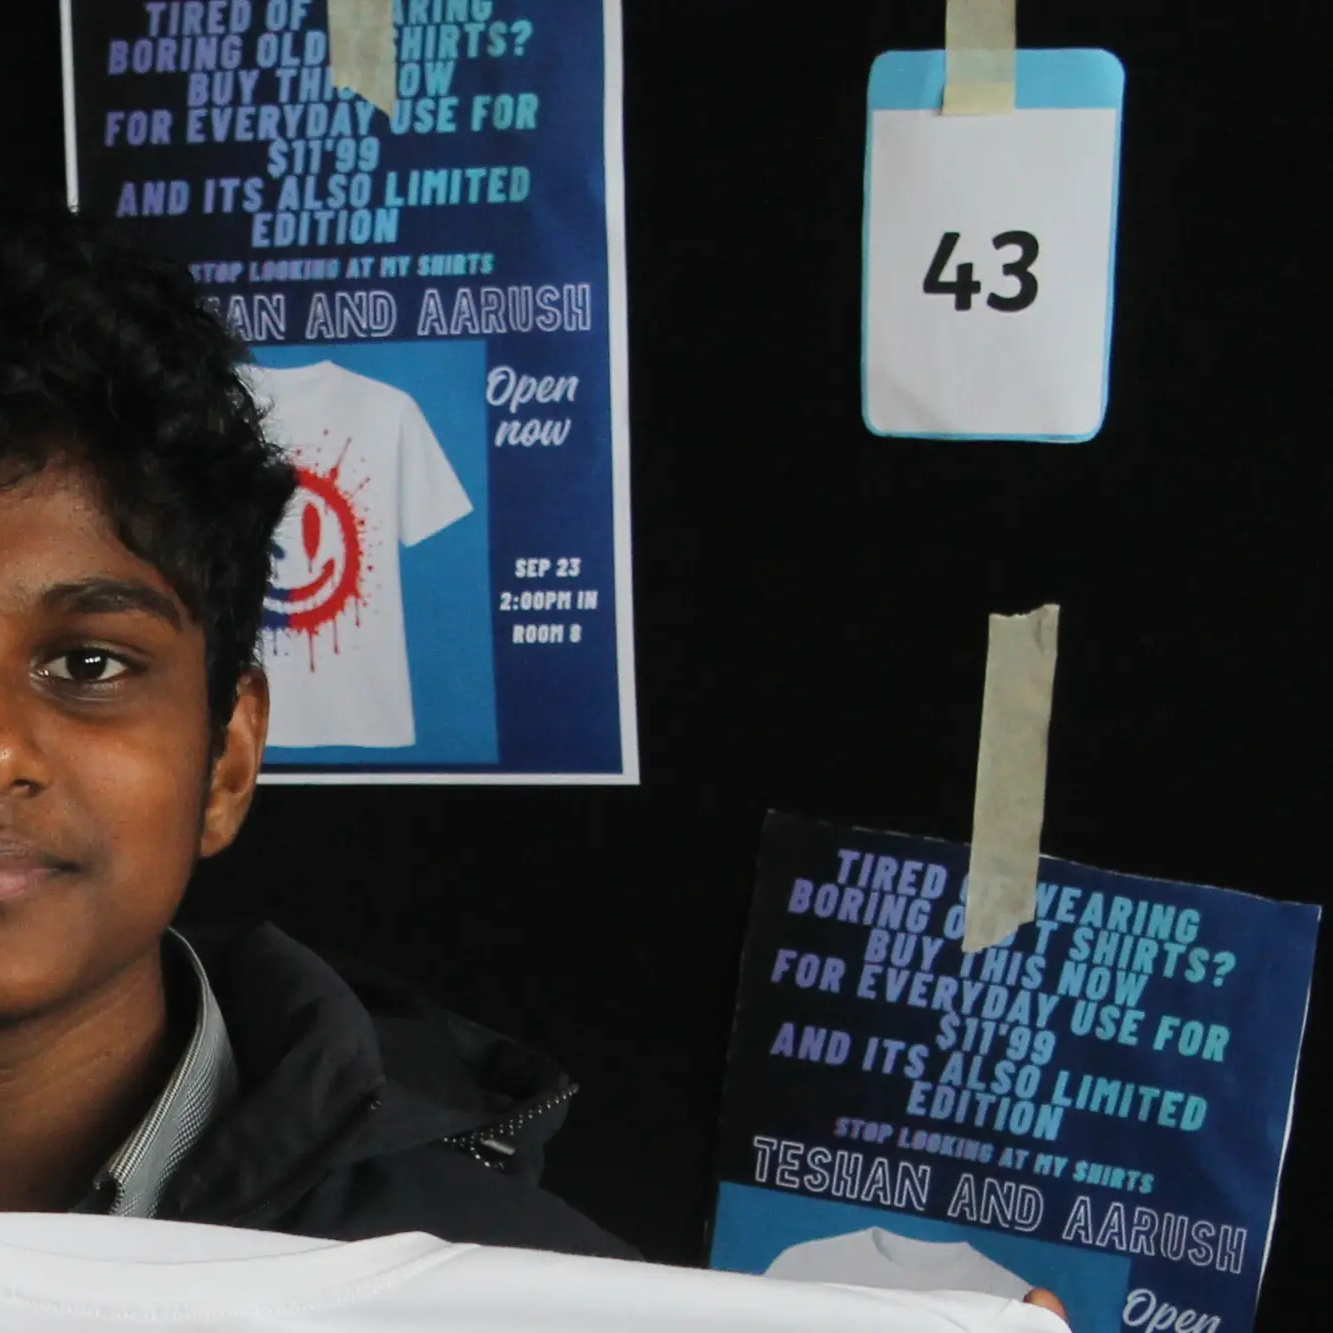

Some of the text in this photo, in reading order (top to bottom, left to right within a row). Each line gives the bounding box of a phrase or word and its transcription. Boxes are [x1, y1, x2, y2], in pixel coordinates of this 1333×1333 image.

[146, 1, 252, 37] TIRED
[267, 0, 309, 31] OF
[109, 20, 533, 75] BORING OLD HIRTS?
[188, 60, 456, 108] BUY THI OW
[104, 93, 539, 147] FOR EVERYDAY USE FOR
[267, 136, 381, 178] $11'99
[116, 166, 531, 218] AND ITS ALSO LIMITED
[251, 208, 399, 249] EDITION
[248, 257, 340, 283] LOOKING
[346, 256, 377, 280] AT
[380, 255, 410, 279] MY
[417, 252, 495, 277] SHIRTS
[922, 229, 1040, 313] 43
[305, 291, 397, 341] AND
[417, 283, 591, 336] AARUSH
[485, 365, 581, 413] Open
[494, 416, 572, 448] now
[514, 556, 581, 578] SEP 23
[499, 589, 598, 611] 2:00PM IN
[512, 623, 564, 644] ROOM
[836, 848, 949, 901] TIRED
[787, 878, 932, 934] BORING
[1034, 920, 1059, 957] T
[1068, 926, 1237, 989] SHIRTS?
[865, 929, 1148, 1009] BUY THIS NOW
[771, 948, 1231, 1063] FOR EVERYDAY USE FOR
[936, 1009, 1057, 1067] $11'99
[771, 1022, 1208, 1133] AND ITS ALSO LIMITED
[906, 1081, 1064, 1142] EDITION
[833, 1116, 1155, 1195] STOP LOOKING AT MY SHIRTS
[753, 1135, 1248, 1274] TESHAN AND AARUSH
